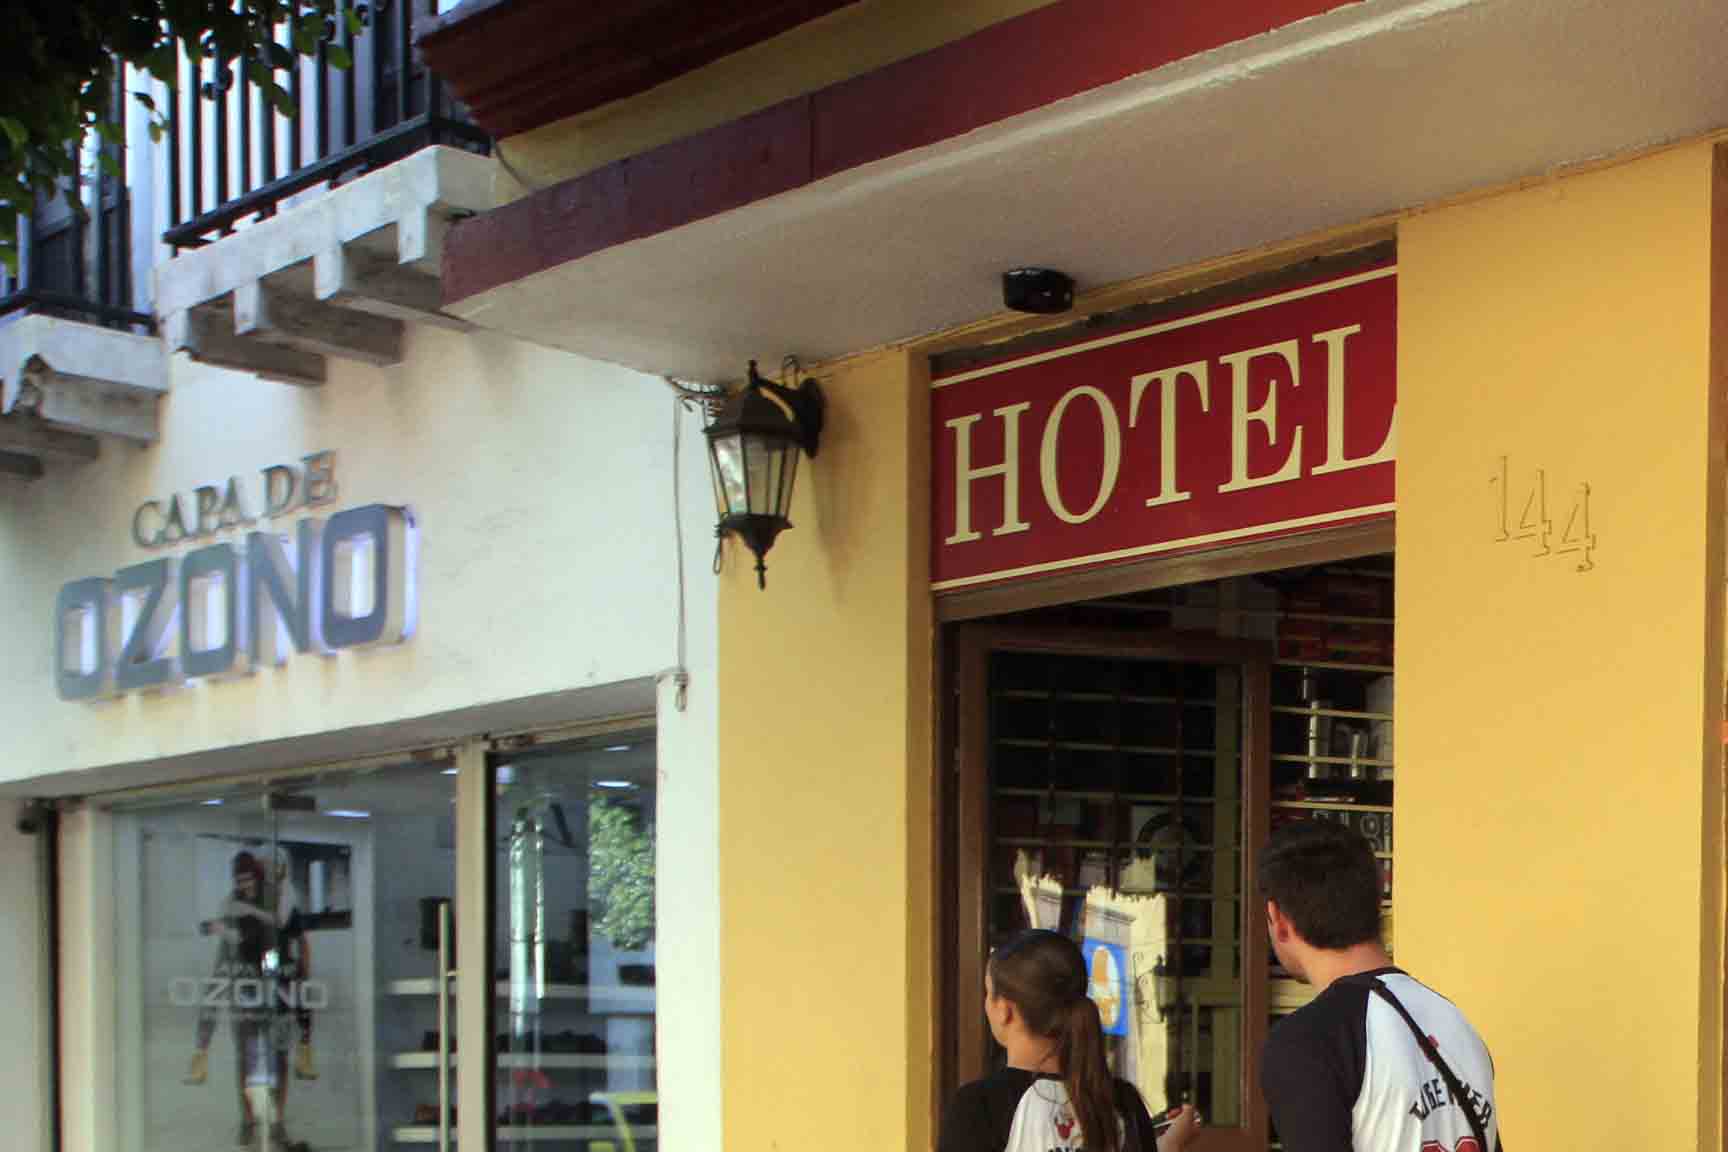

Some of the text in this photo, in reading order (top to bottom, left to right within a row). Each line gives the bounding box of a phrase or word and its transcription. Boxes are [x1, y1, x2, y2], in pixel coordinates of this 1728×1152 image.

[132, 451, 340, 549] CAPA DE
[944, 324, 1396, 545] HOTEL
[56, 504, 410, 702] OZONO
[168, 977, 328, 1009] OZONO
